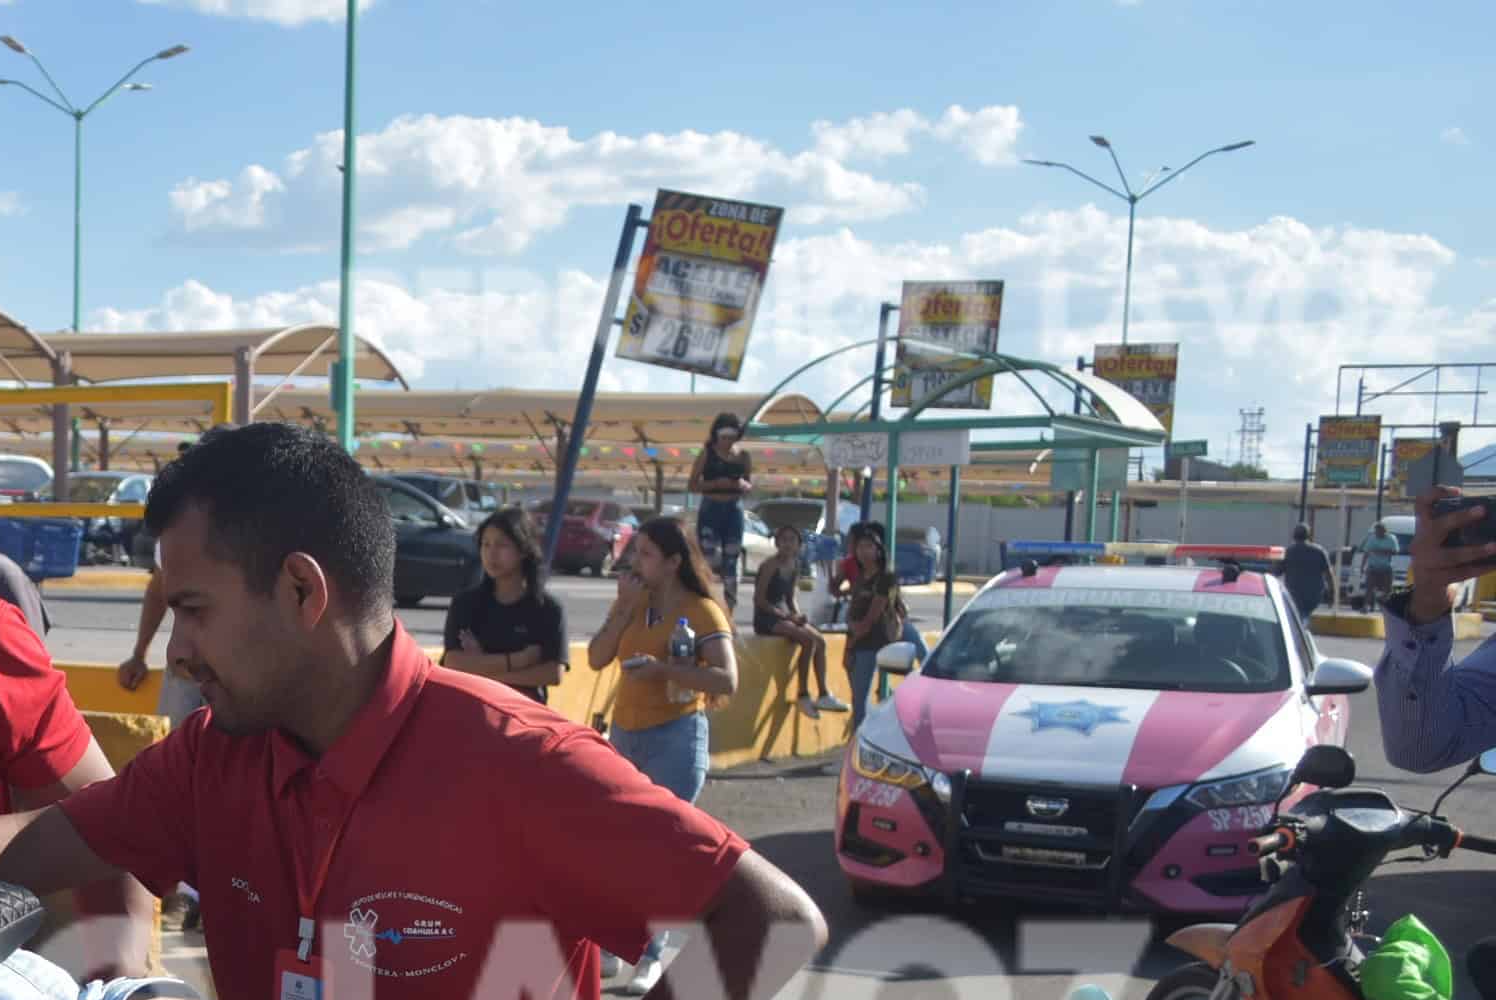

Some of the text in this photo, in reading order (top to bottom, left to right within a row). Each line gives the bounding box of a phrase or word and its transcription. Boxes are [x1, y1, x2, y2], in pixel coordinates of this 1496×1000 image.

[709, 200, 768, 222] ZONA DE
[405, 952, 467, 977] MONCLOVA
